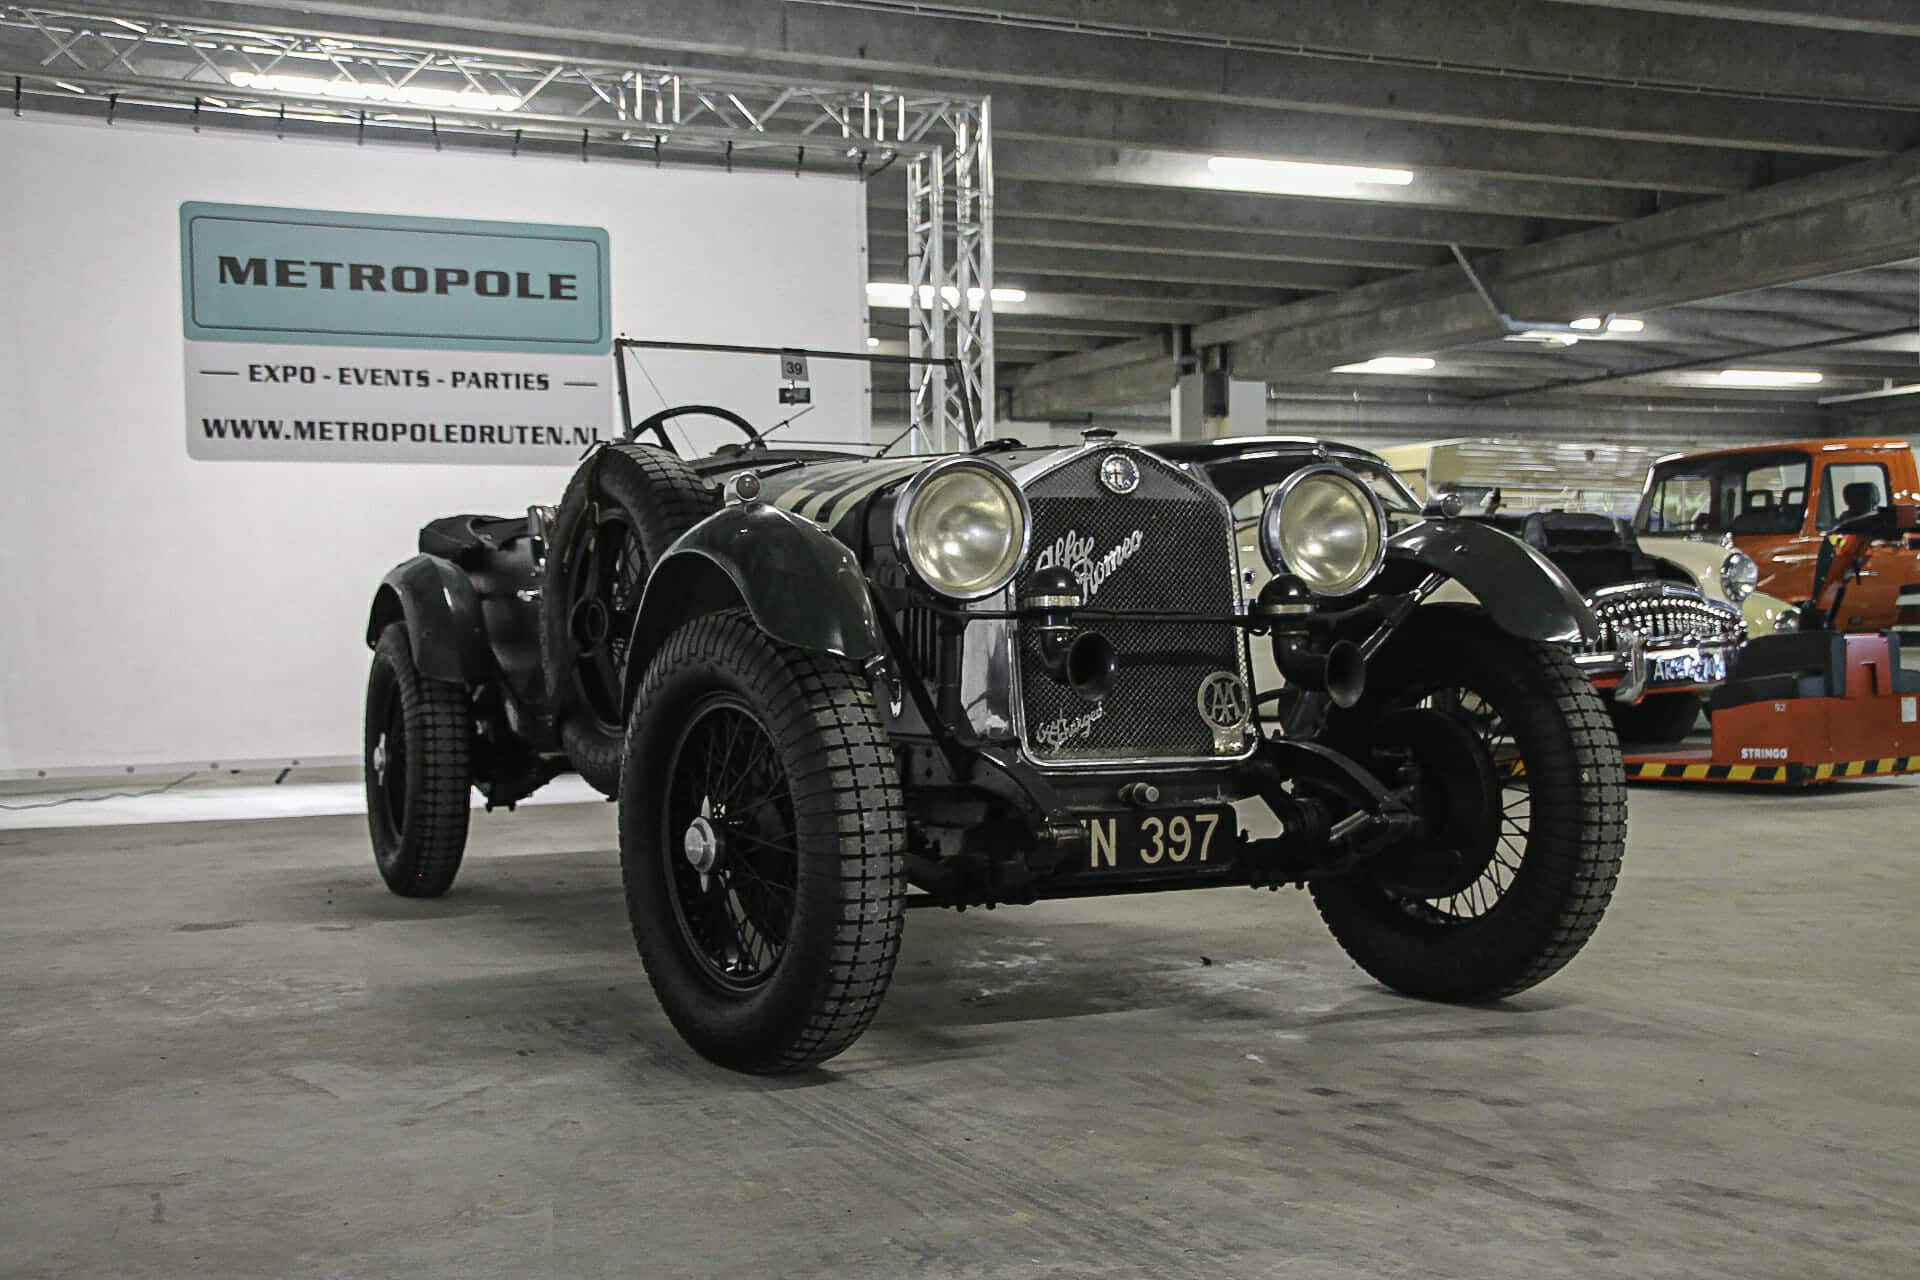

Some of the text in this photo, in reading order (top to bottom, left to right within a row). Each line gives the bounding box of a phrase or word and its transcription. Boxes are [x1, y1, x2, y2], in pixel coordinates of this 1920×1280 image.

[217, 255, 578, 300] METROPOLE
[248, 364, 549, 391] EXPO EVENTS PARTIES
[786, 362, 803, 375] 39
[1741, 747, 1788, 759] STRINGO
[1140, 814, 1219, 864] 397
